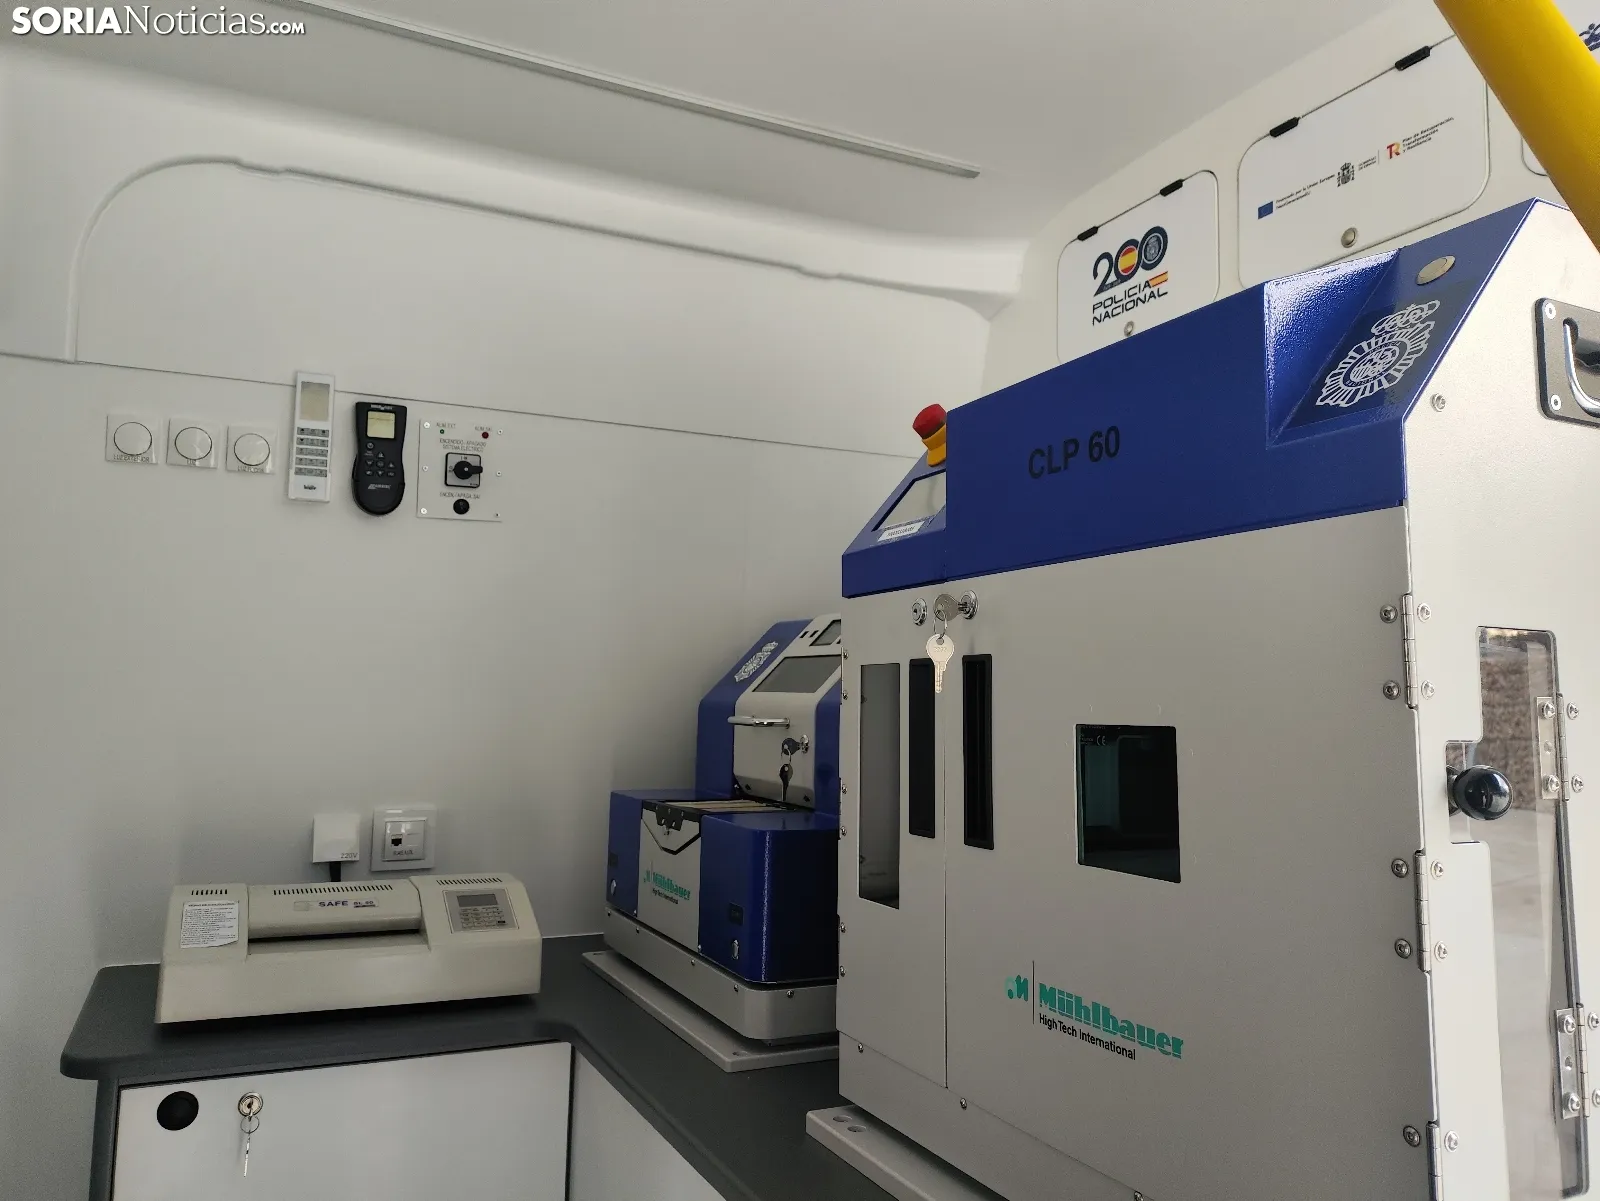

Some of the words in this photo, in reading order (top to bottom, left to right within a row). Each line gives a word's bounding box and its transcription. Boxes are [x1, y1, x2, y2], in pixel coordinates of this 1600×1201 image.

[1093, 226, 1168, 297] 200
[1092, 287, 1169, 326] NACIONAL
[1028, 437, 1080, 479] CLP
[1088, 425, 1121, 462] 60
[1038, 982, 1184, 1059] Mühlbauer
[1038, 1013, 1058, 1030] High
[1058, 1020, 1078, 1038] Tech
[1079, 1028, 1136, 1060] International
